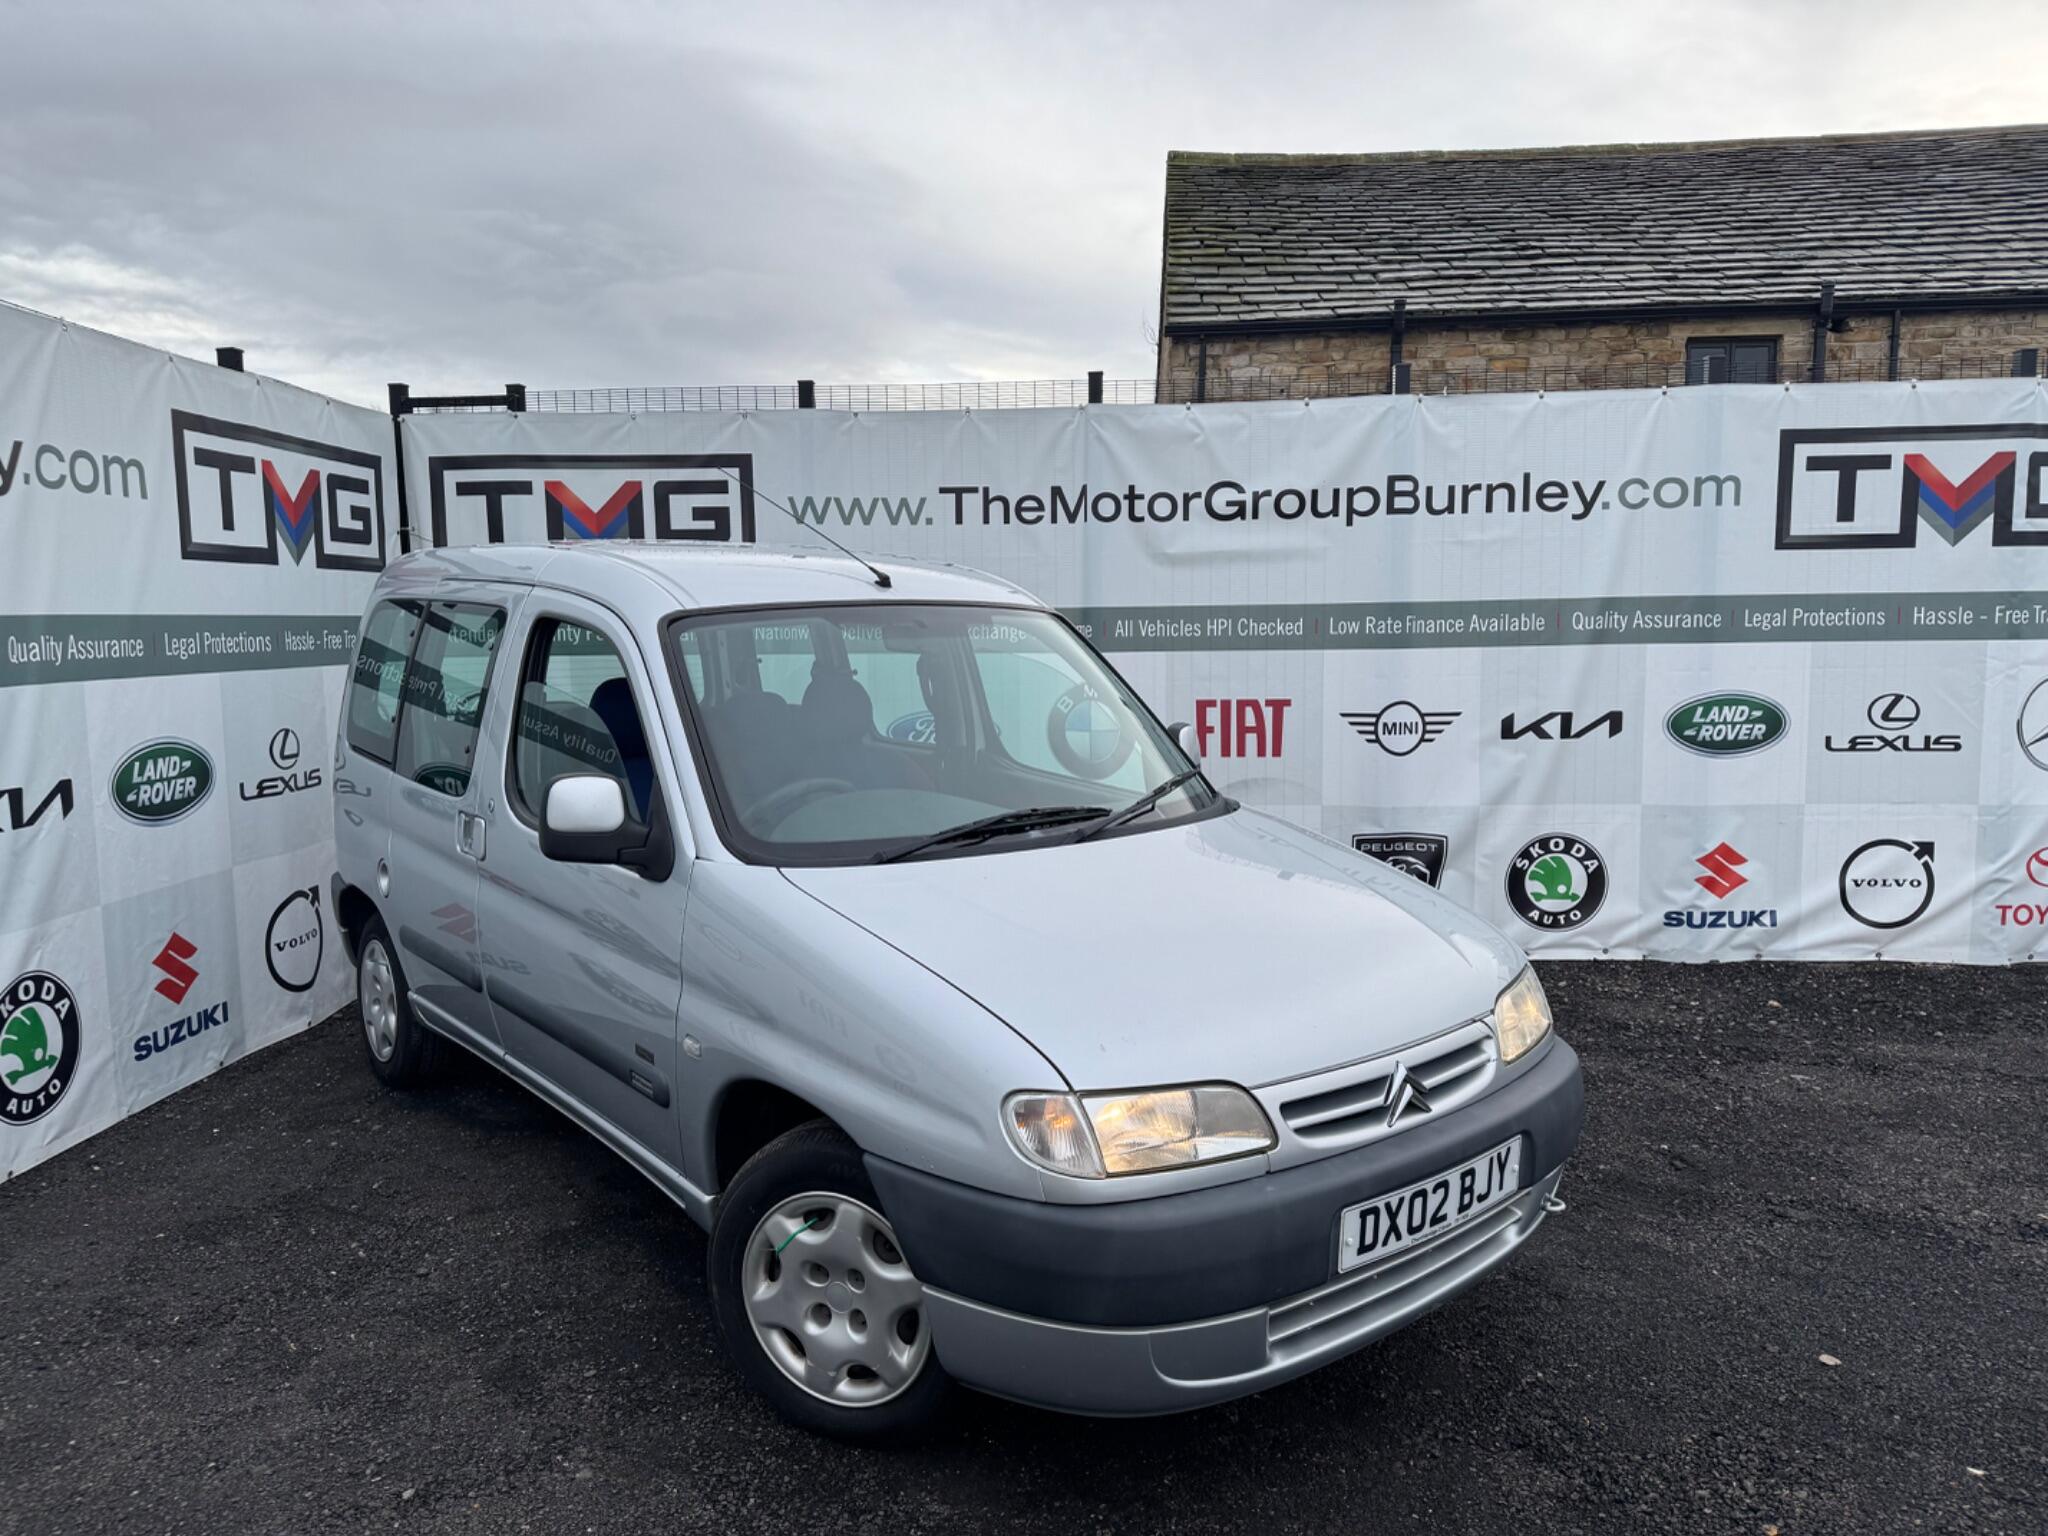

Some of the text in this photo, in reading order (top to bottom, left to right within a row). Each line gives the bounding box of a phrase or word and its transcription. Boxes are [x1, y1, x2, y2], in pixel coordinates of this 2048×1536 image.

[194, 446, 373, 567] TMG
[455, 480, 729, 542] TMG
[787, 471, 1742, 527] www.TheMotorGroupBurnley.com
[1805, 450, 2048, 547] TM
[1115, 619, 1133, 638] All
[1138, 617, 1201, 638] Vehicles
[1207, 618, 1232, 637] HPI
[1237, 617, 1304, 637] Checked
[1329, 612, 1546, 635] Low Rate Finance Available
[1571, 609, 1722, 633] Quality Assurance
[1744, 606, 1886, 631] Legal Protections
[1913, 606, 1974, 625] Hassle
[1994, 604, 2030, 625] Free
[2033, 604, 2048, 625] Tr
[7, 634, 145, 665] Quality Assurance
[164, 631, 272, 660] Legal Protections
[284, 630, 315, 651] Hassle
[323, 629, 342, 649] Free
[1195, 697, 1293, 759] FIAT
[1381, 720, 1420, 737] MINI
[1824, 734, 1963, 753] LEXUS
[239, 768, 322, 802] LEXUS
[1360, 842, 1438, 853] PEUGEOT
[1515, 838, 1599, 874] SKODA
[1851, 877, 1923, 889] VOLVO
[1528, 909, 1582, 925] AUTO
[1662, 909, 1778, 930] SUZUKI
[273, 927, 319, 953] VOLVO
[133, 1000, 230, 1062] SUZUKI
[6, 1078, 62, 1115] AUTO
[1356, 1178, 1450, 1256] DX02
[1456, 1145, 1512, 1217] BJY
